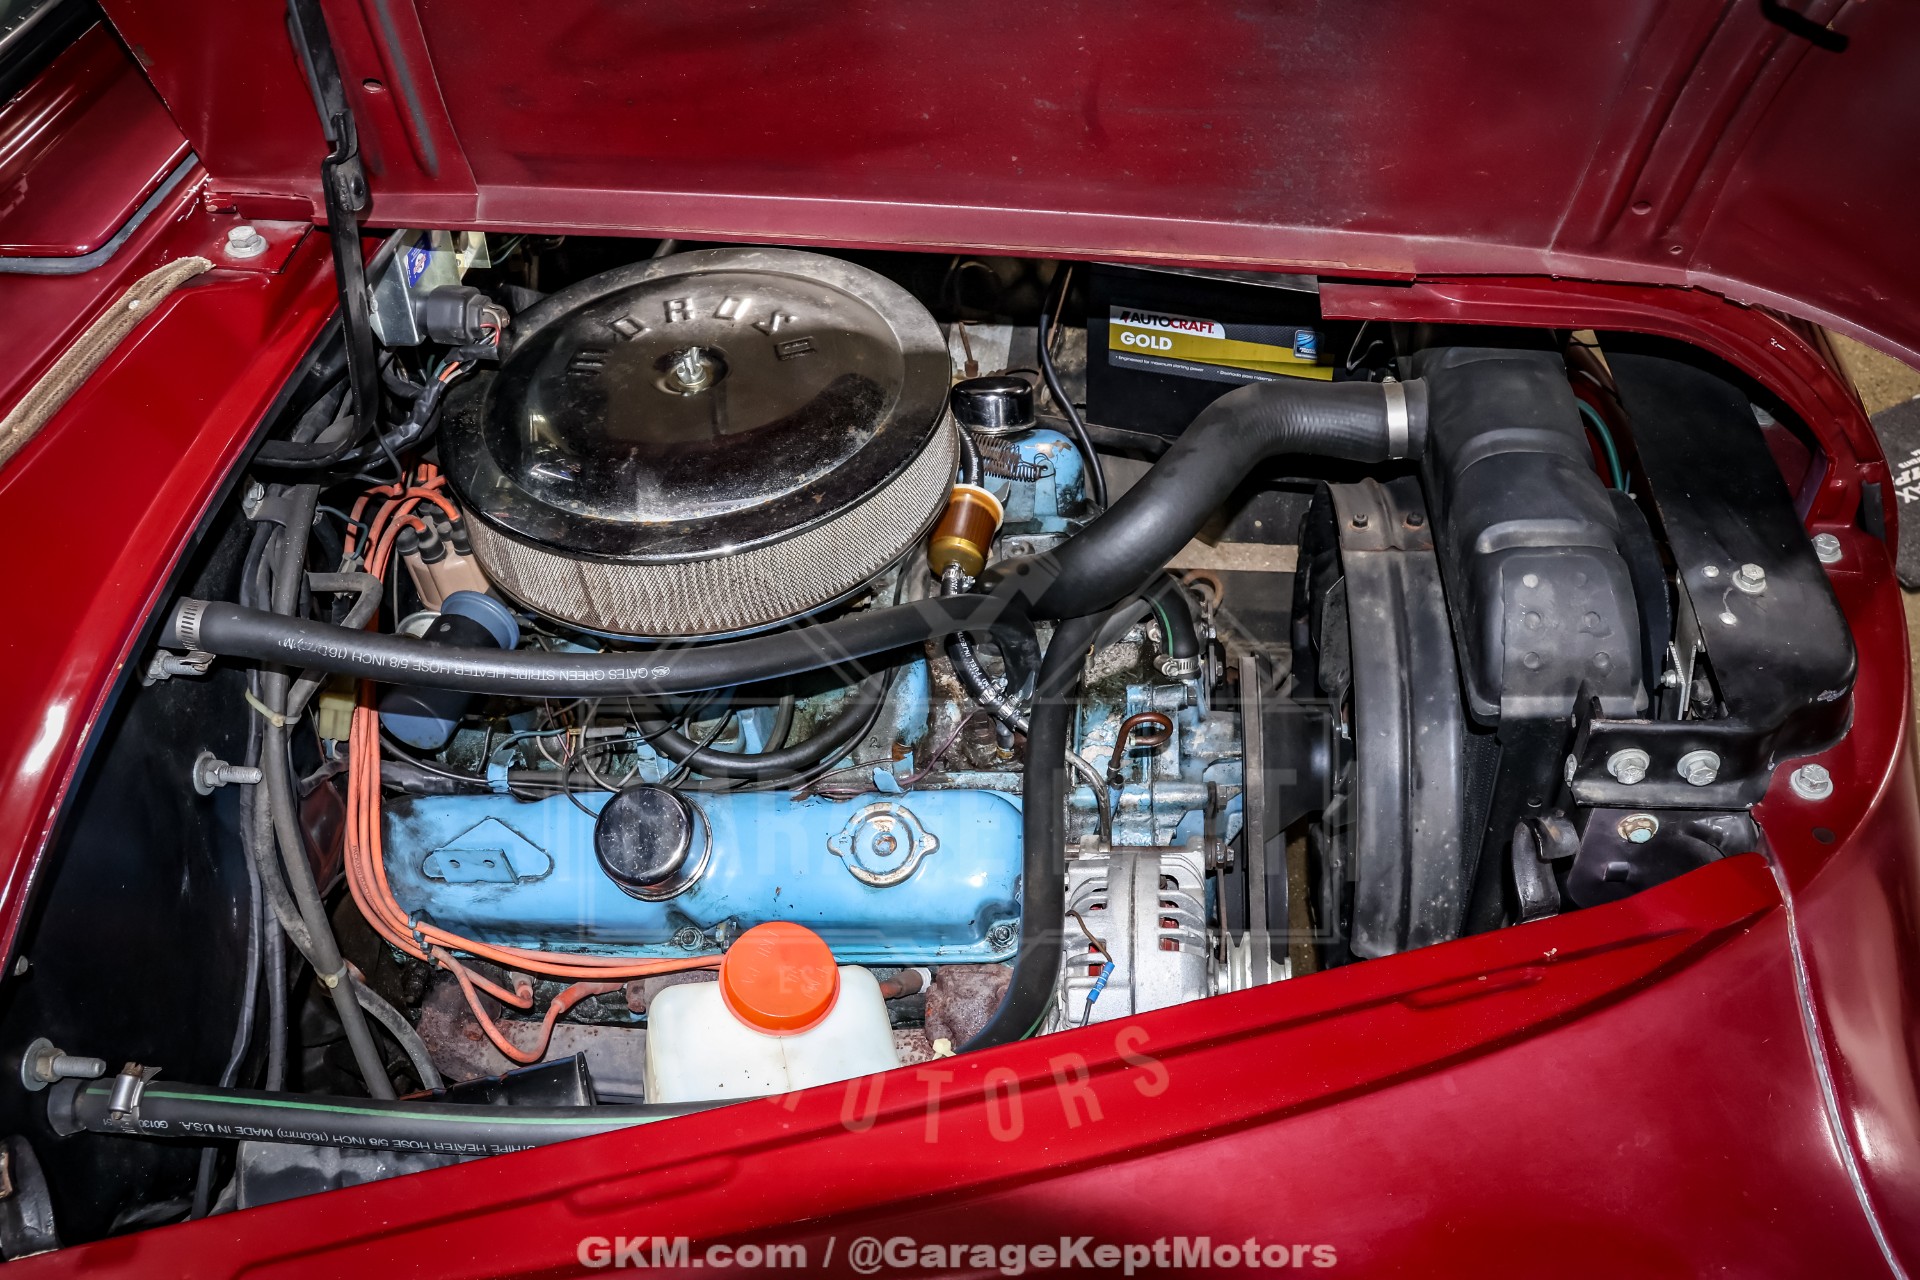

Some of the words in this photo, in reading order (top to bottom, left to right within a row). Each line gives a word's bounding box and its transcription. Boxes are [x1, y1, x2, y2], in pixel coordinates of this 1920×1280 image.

[1129, 312, 1215, 335] AUTOCRAFT
[1120, 331, 1173, 351] GOLD
[351, 650, 386, 667] INCH
[389, 656, 409, 669] 5/8
[412, 659, 450, 674] HOSE
[453, 664, 508, 680] HEATER
[968, 659, 983, 677] FUEL
[509, 668, 556, 681] STRIPE
[558, 668, 605, 681] GREEN
[608, 667, 649, 681] GATES
[178, 1121, 215, 1134] U.S.A.
[216, 1123, 232, 1135] IN
[233, 1125, 274, 1138] MADE
[276, 1127, 329, 1143] (16.0mm)
[332, 1133, 367, 1147] INCH
[368, 1136, 389, 1148] 5/8
[391, 1138, 431, 1151] HOSE
[433, 1140, 487, 1153] HEATER
